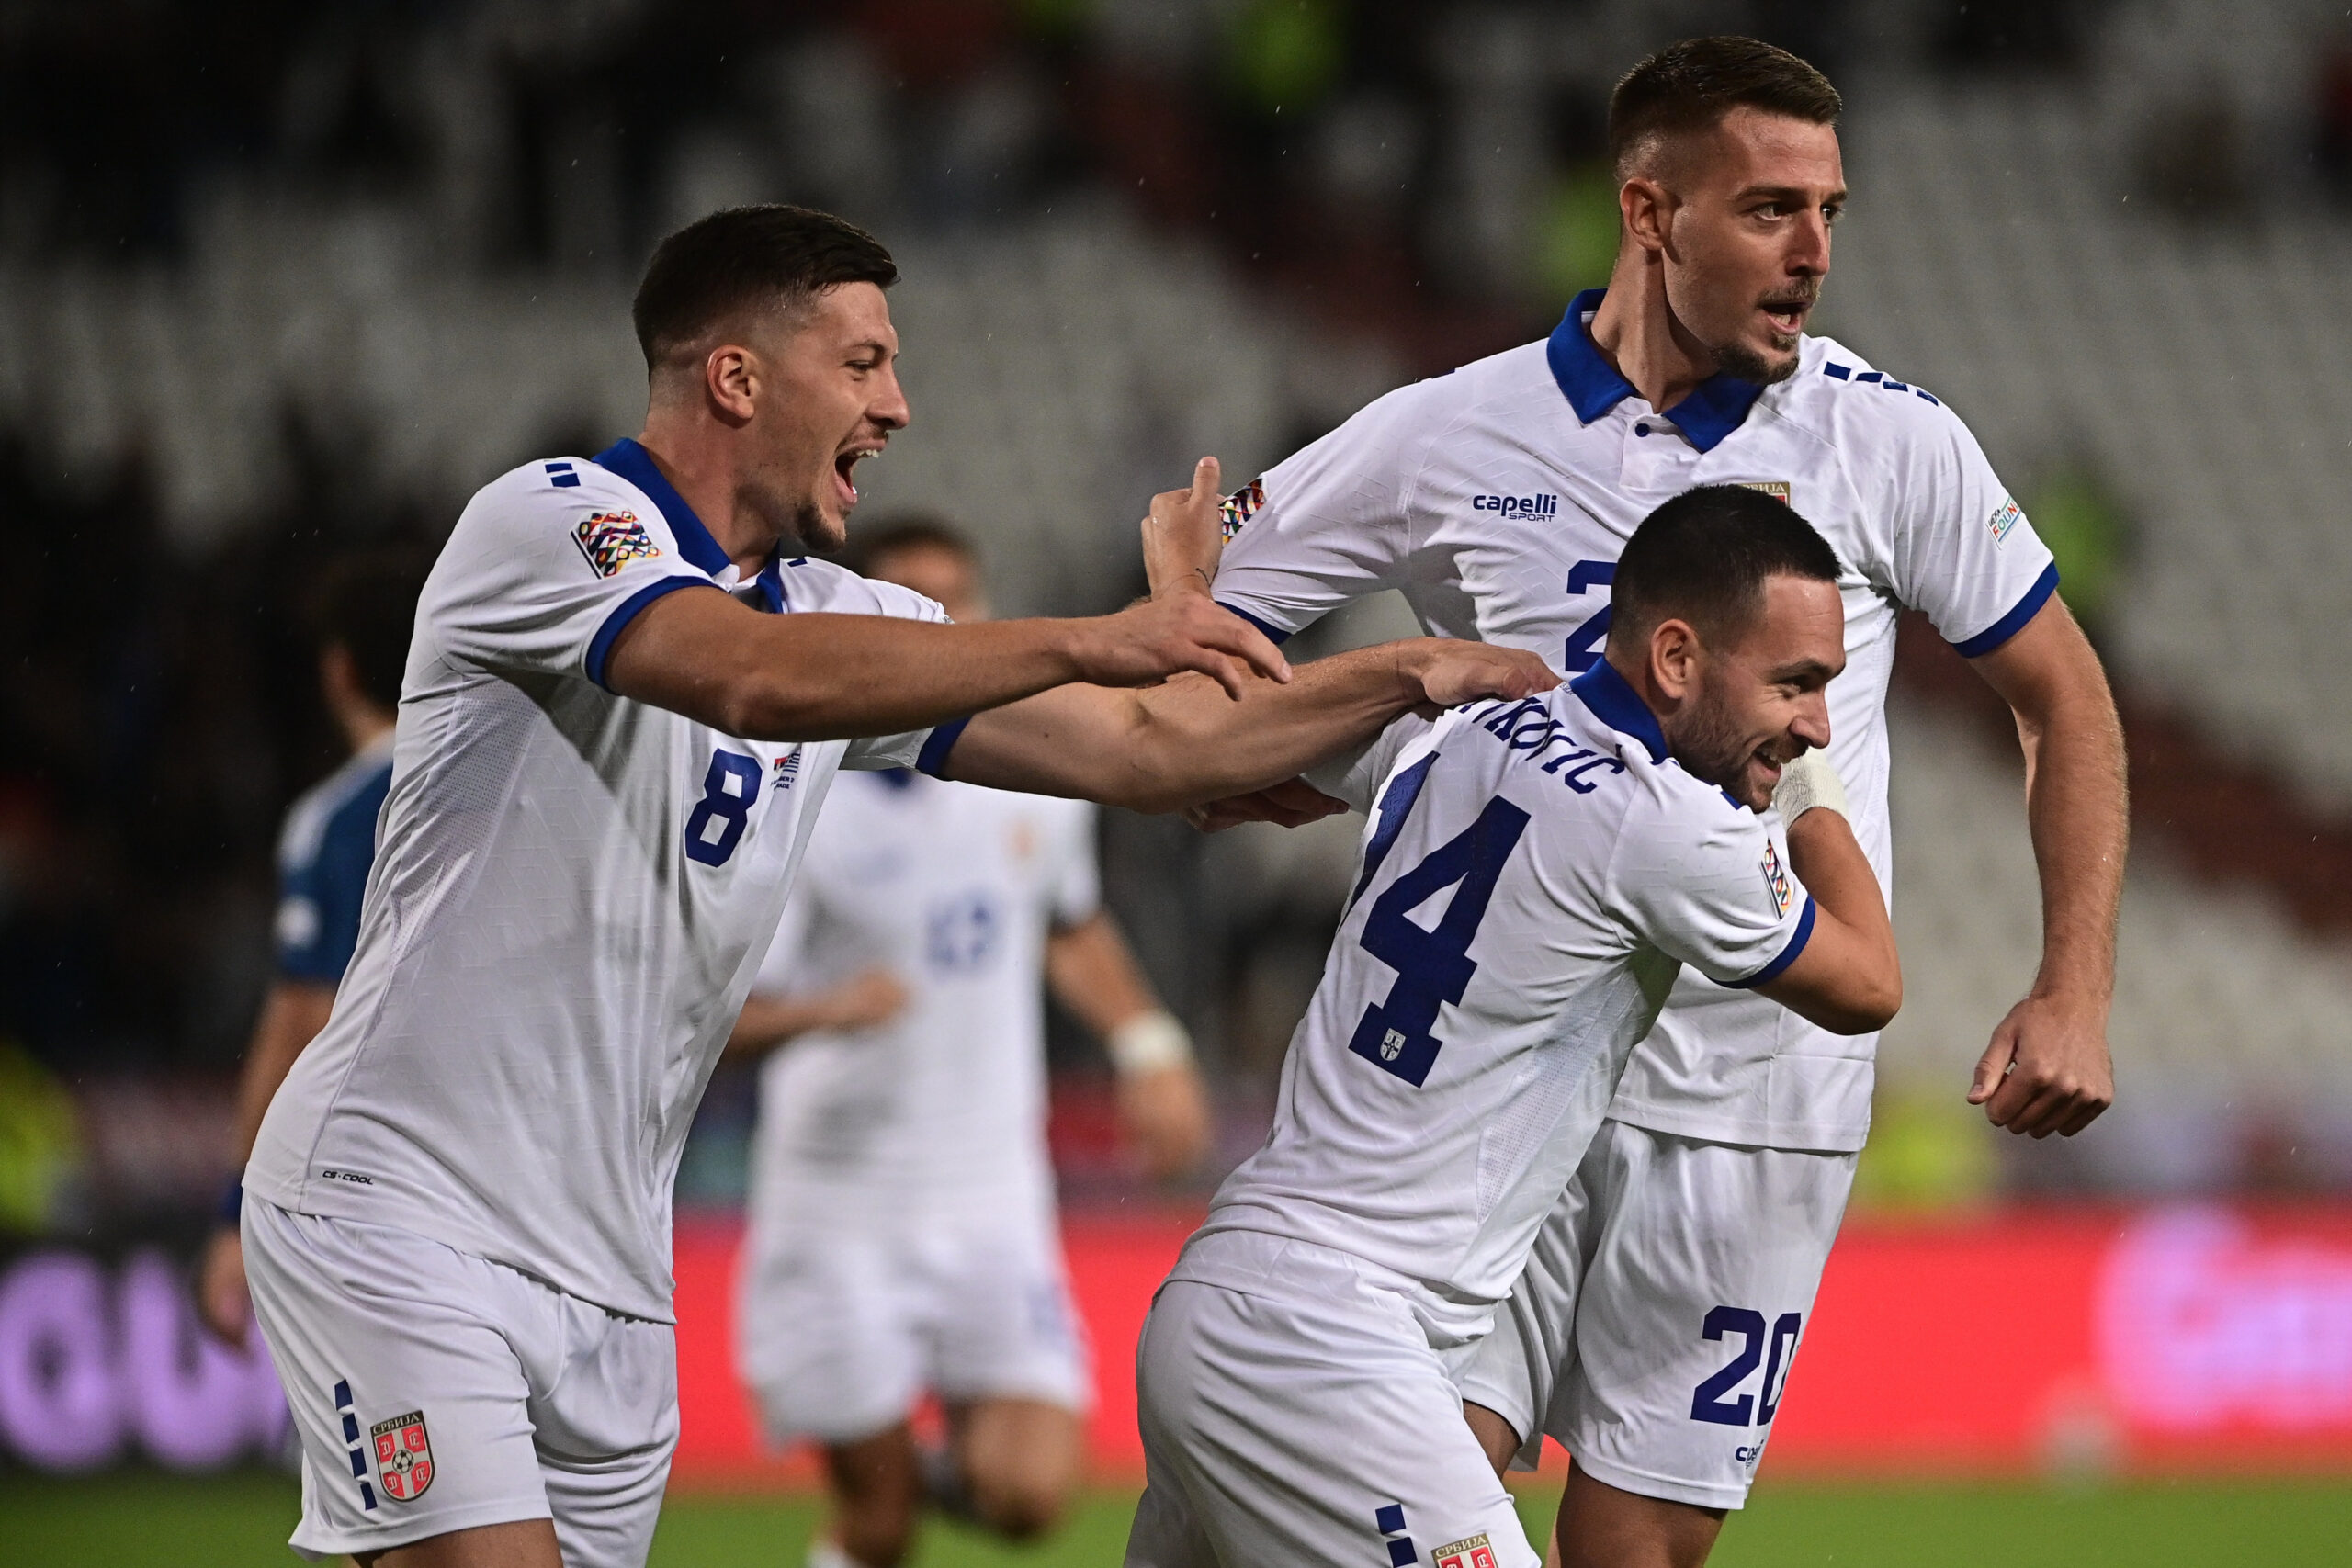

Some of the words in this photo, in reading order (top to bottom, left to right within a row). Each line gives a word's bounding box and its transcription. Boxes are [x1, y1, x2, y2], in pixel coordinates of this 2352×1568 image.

[1473, 493, 1557, 517] capelli
[1508, 512, 1555, 523] SPORT
[1993, 502, 2018, 539] FOUN
[685, 748, 763, 868] 8
[1690, 1305, 1801, 1427] 20
[373, 1414, 420, 1434] СРБИЈА
[1435, 1535, 1487, 1557] СРБИЈА
